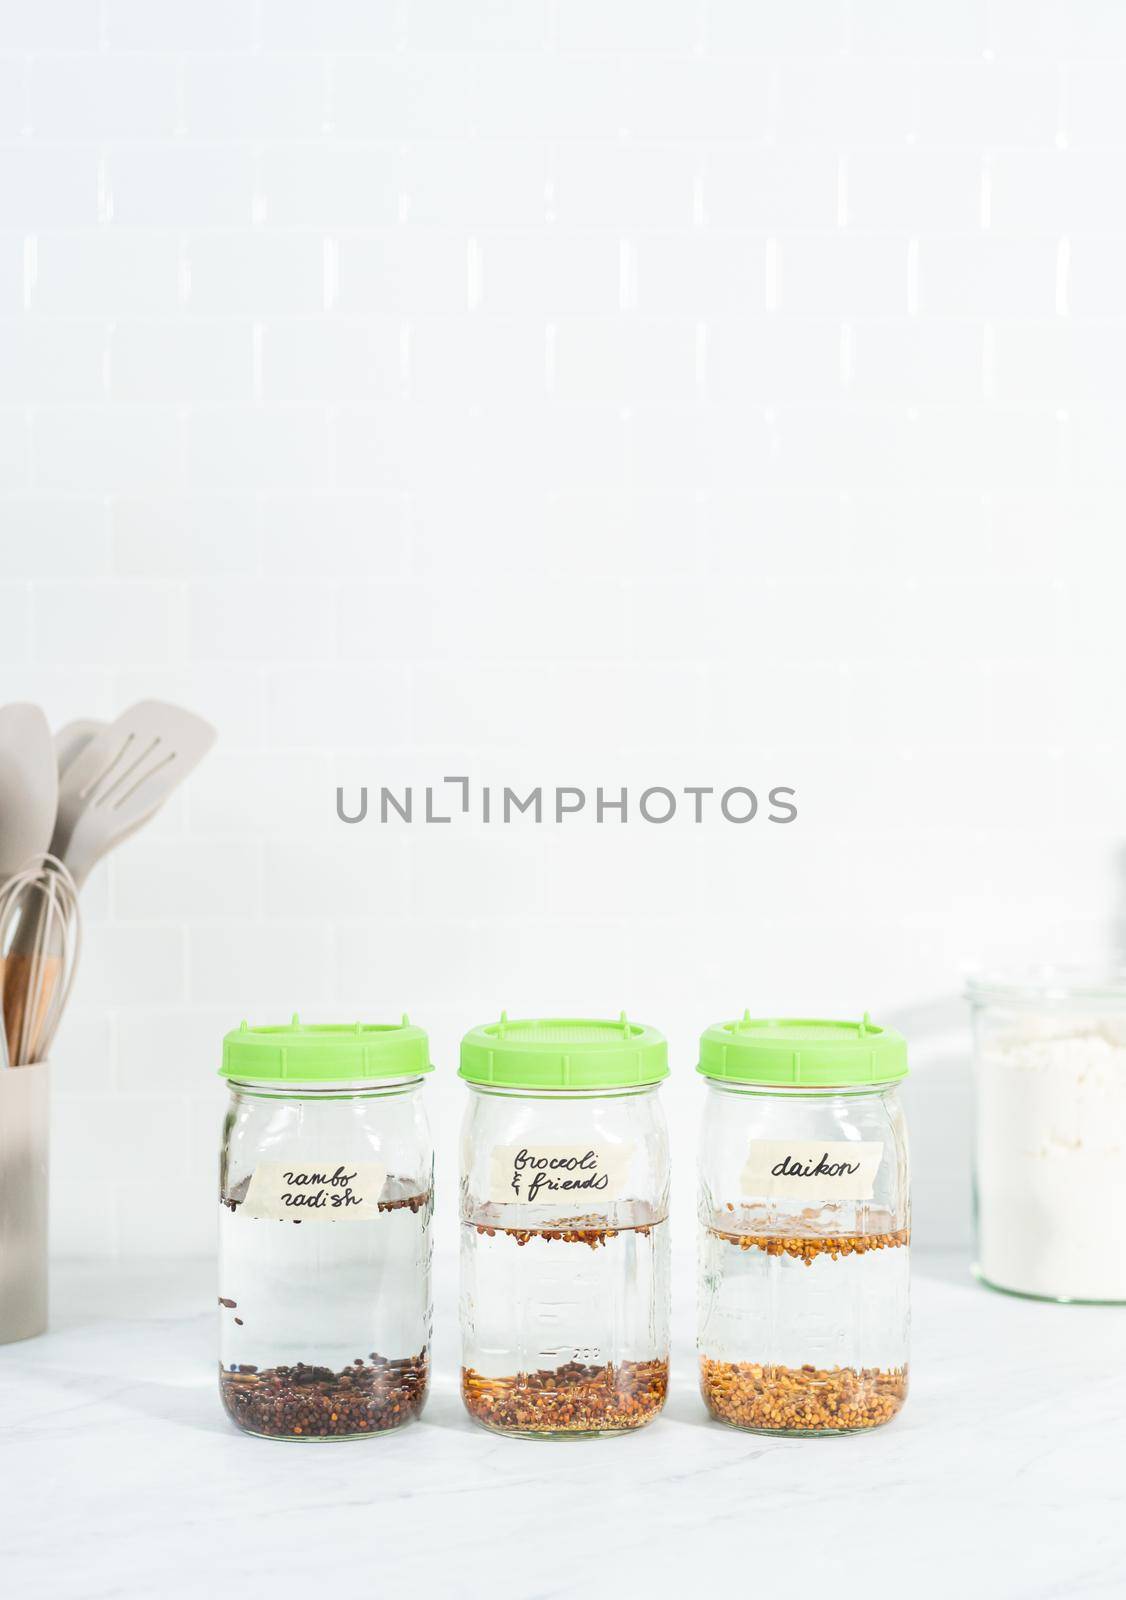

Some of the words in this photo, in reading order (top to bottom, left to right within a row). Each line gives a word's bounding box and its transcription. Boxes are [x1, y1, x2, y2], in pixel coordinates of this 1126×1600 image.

[282, 1165, 358, 1188] rambo
[771, 1152, 861, 1178] daikon
[280, 1187, 363, 1208] radish
[527, 1171, 610, 1202] friends
